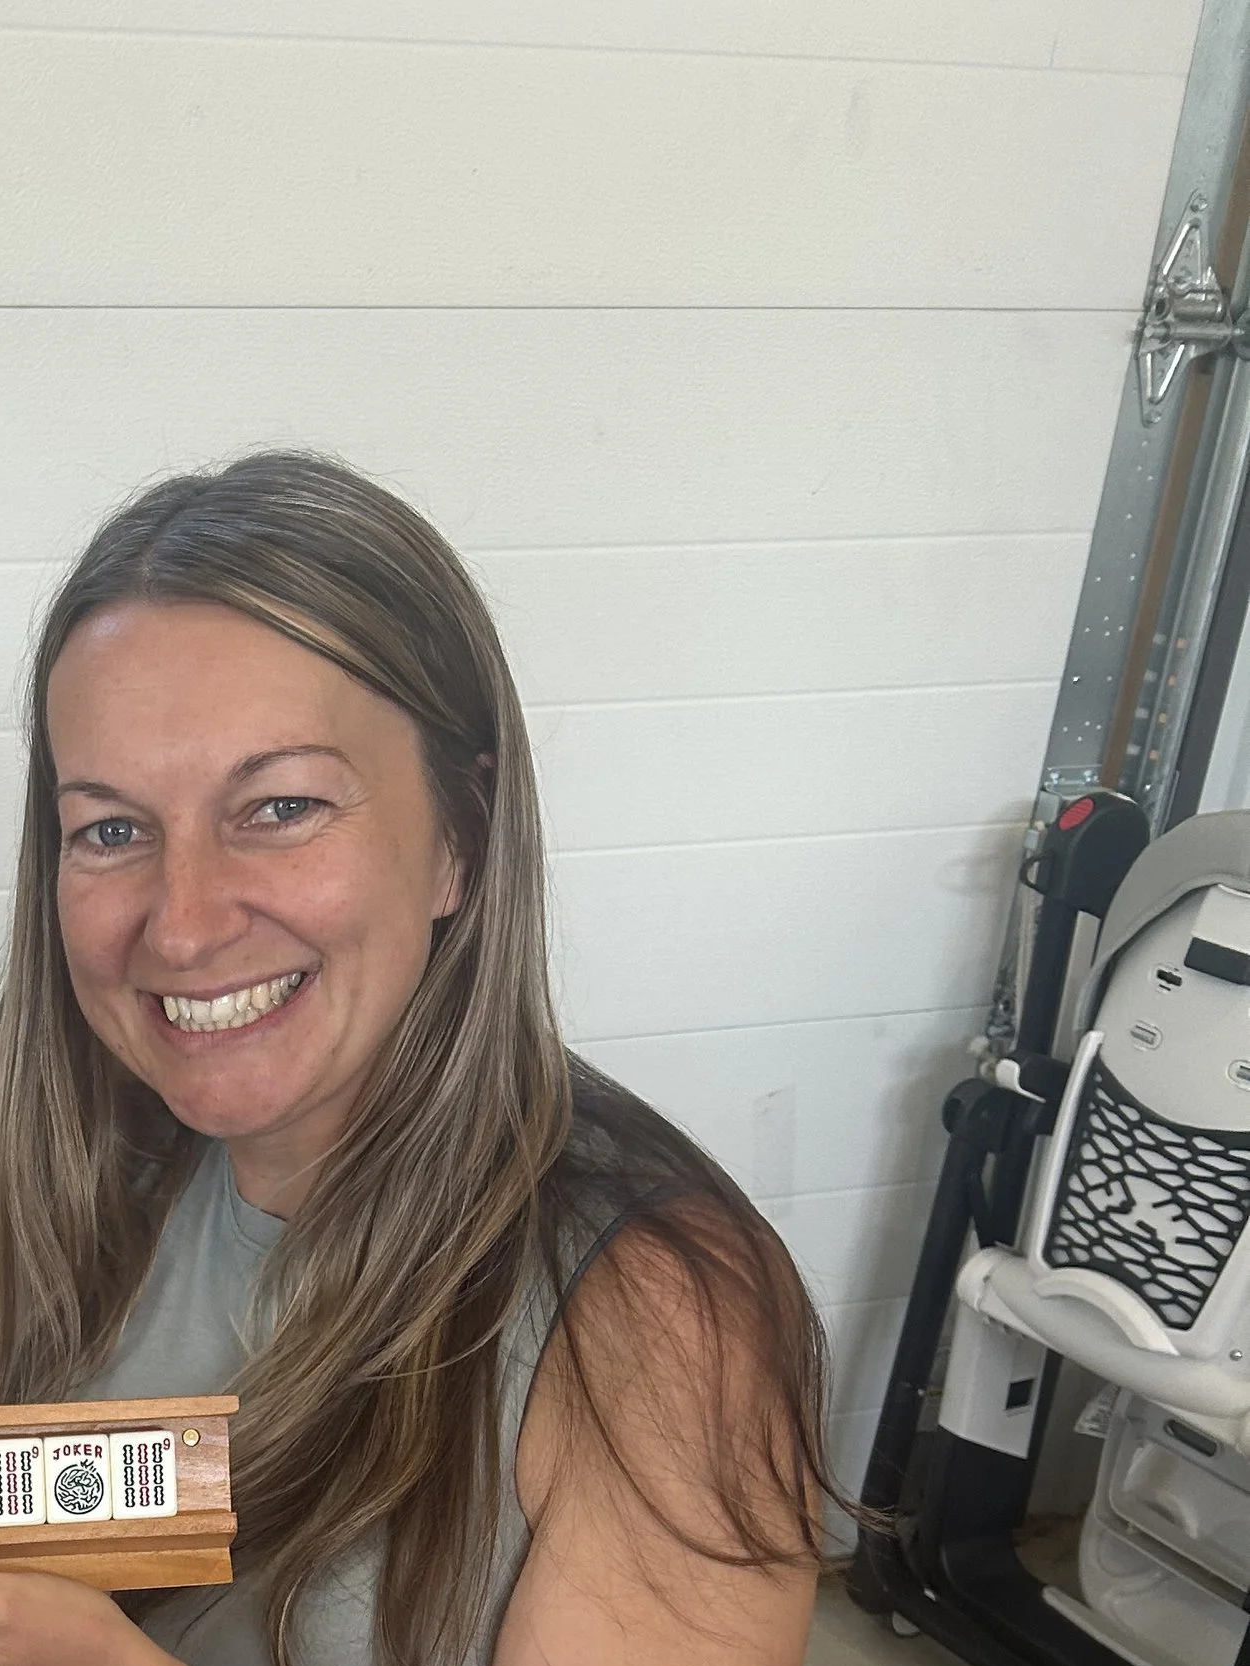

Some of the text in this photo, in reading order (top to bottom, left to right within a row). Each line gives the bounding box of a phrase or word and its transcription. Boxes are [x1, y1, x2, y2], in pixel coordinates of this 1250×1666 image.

[164, 1438, 171, 1450] 9
[32, 1447, 39, 1459] 9
[53, 1444, 103, 1460] JOKER
